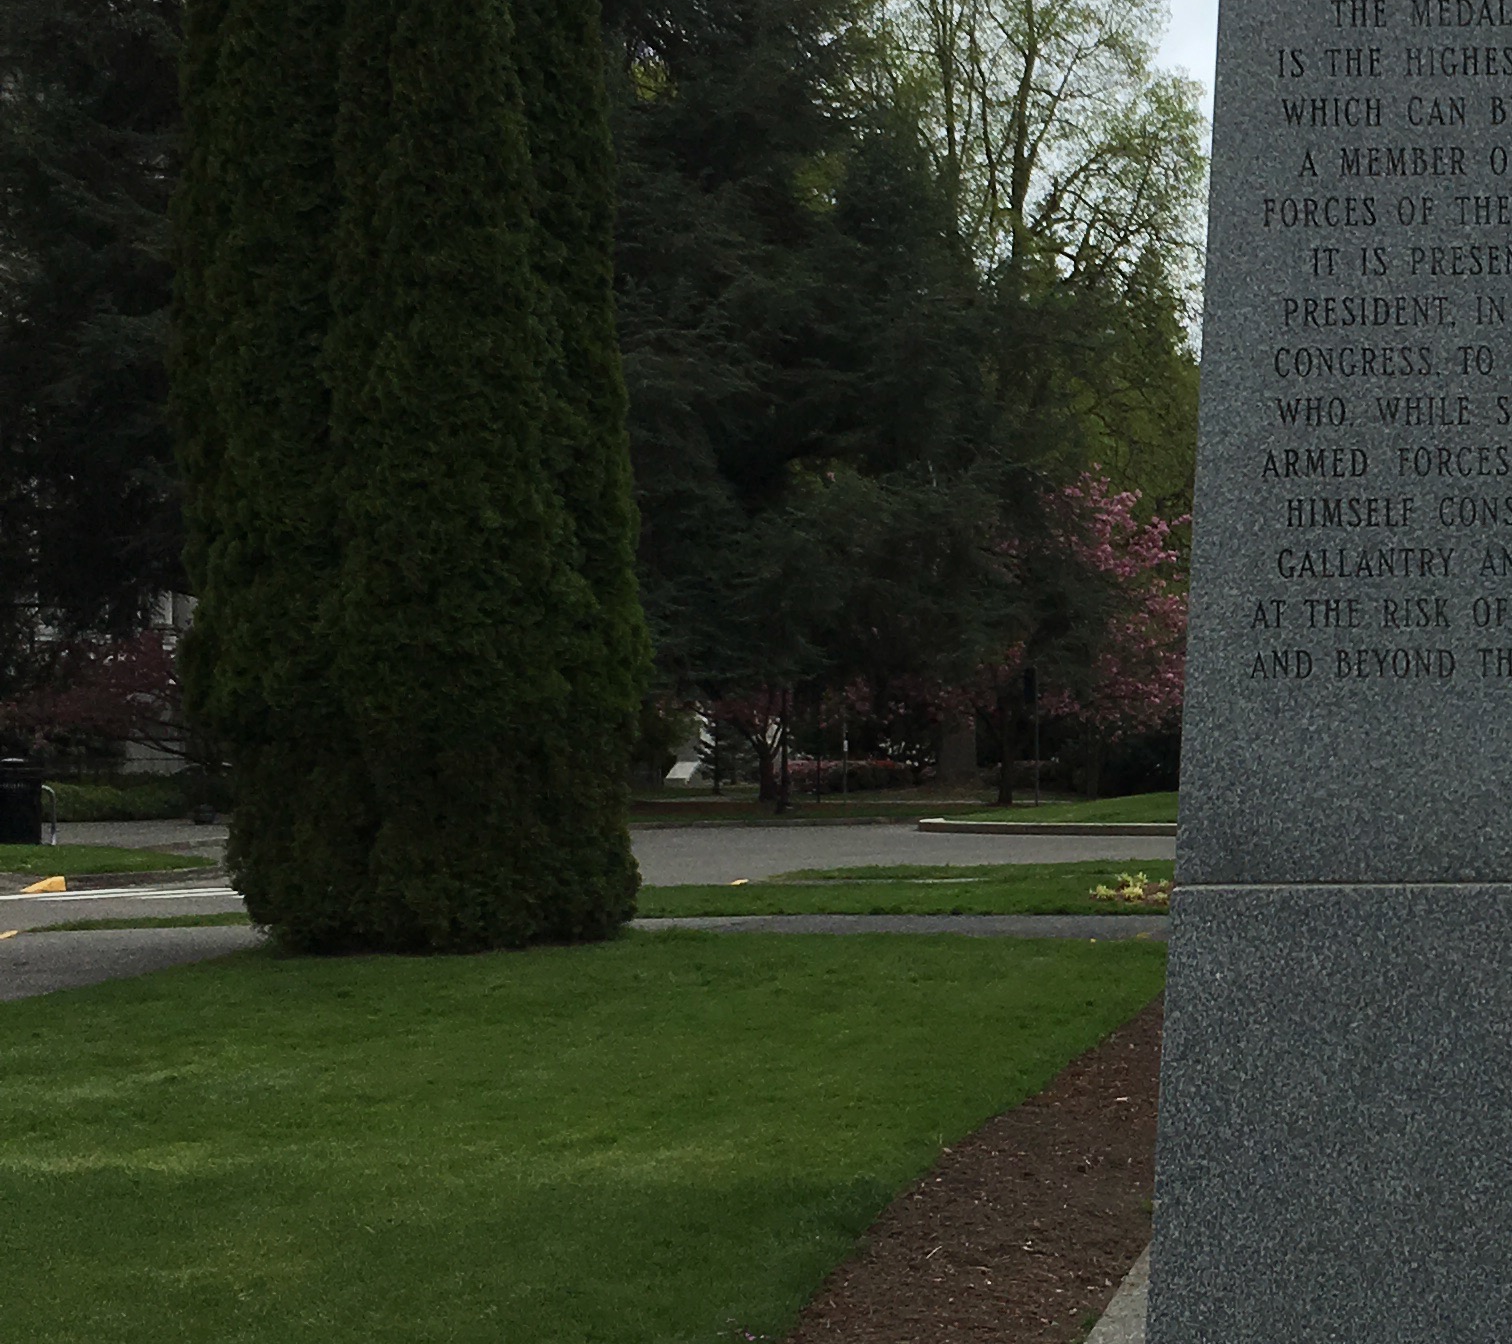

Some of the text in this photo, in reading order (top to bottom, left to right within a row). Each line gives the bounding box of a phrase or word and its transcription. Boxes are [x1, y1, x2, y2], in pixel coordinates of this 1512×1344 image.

[1331, 0, 1387, 28] THE
[1278, 49, 1304, 78] IS
[1325, 48, 1381, 77] THE
[1282, 98, 1381, 127] WHICH
[1408, 97, 1466, 127] CAN
[1299, 148, 1318, 178] A
[1340, 147, 1467, 177] MEMBER
[1262, 198, 1376, 228] FORCES
[1399, 197, 1435, 227] OF
[1455, 196, 1510, 226] THE
[1310, 248, 1339, 277] IT
[1361, 248, 1386, 276] IS
[1475, 296, 1506, 326] IN
[1460, 347, 1494, 376] TO
[1377, 397, 1470, 427] WHILE
[1262, 449, 1368, 479] ARMED
[1286, 498, 1413, 528] HIMSELF
[1277, 547, 1454, 579] GALLANTRY
[1252, 599, 1287, 629] AT
[1304, 599, 1359, 629] THE
[1382, 598, 1451, 628] RISK
[1473, 598, 1508, 627] OF
[1250, 649, 1312, 679] AND
[1335, 648, 1455, 679] BEYOND
